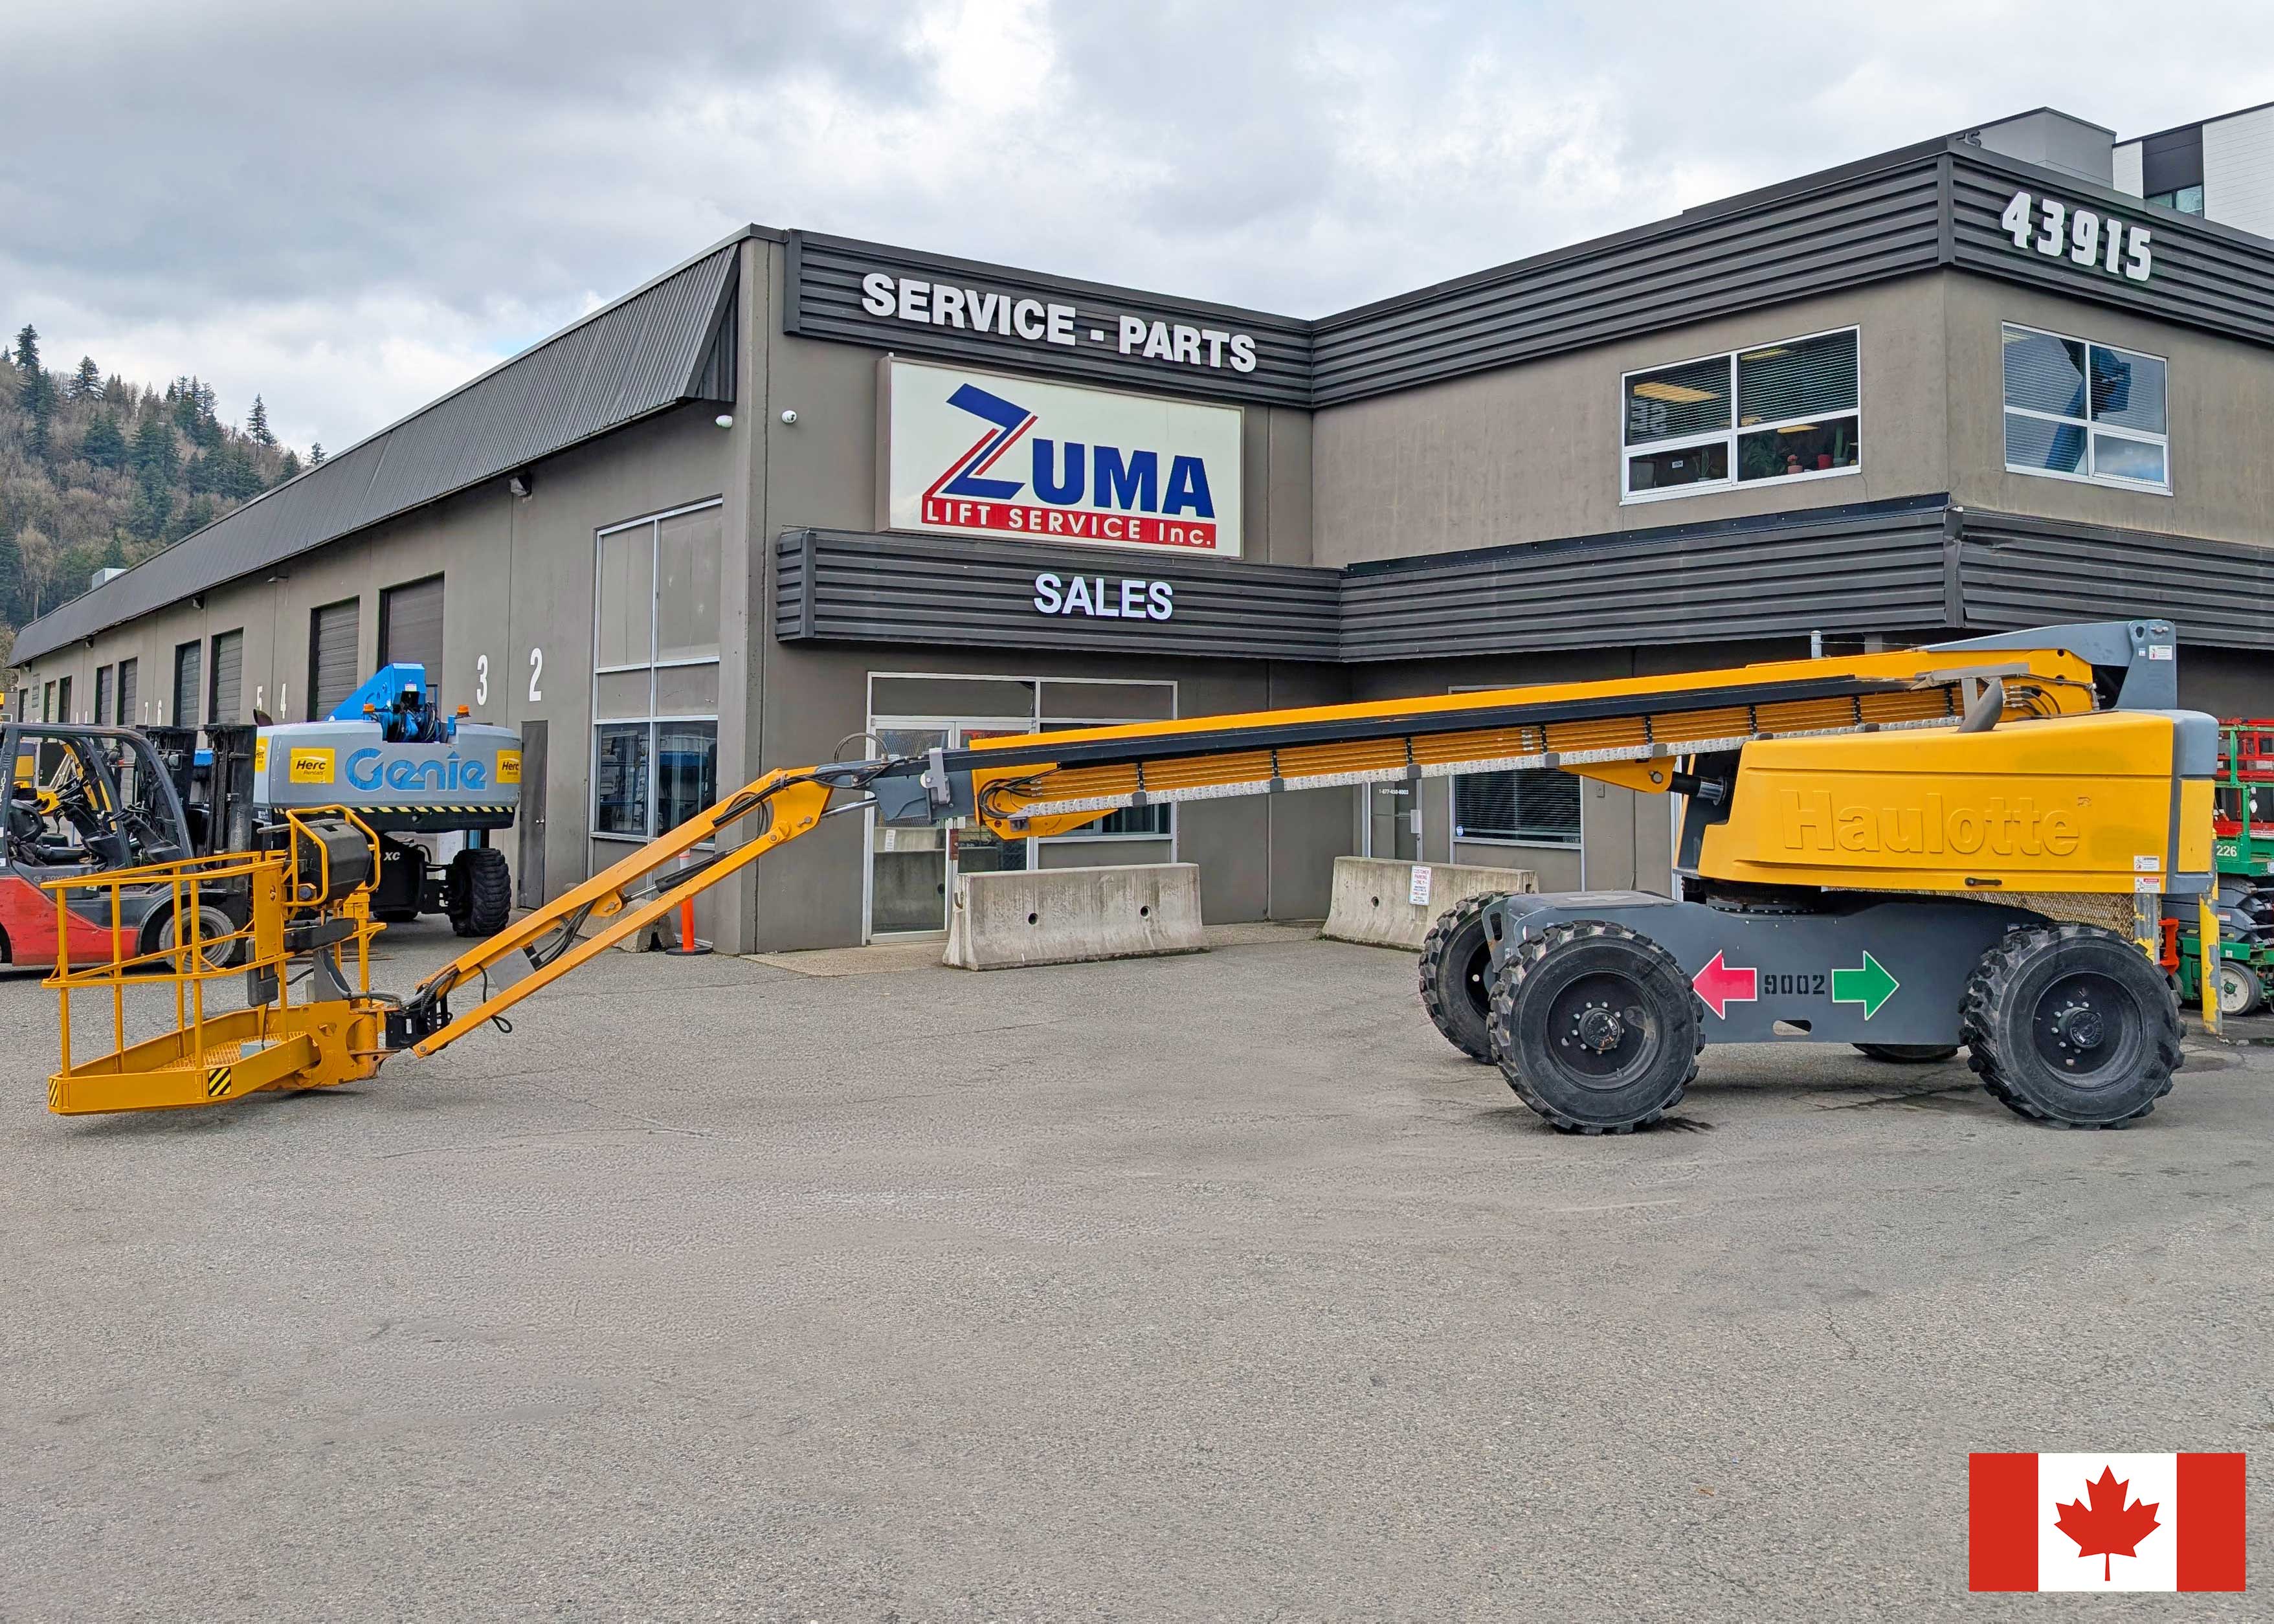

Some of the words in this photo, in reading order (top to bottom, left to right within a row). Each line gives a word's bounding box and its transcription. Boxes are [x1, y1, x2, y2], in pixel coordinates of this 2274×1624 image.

[2001, 191, 2152, 282] 43915
[862, 273, 1076, 347] SERVICE
[1119, 315, 1257, 373] PARTS
[926, 383, 1216, 518] ZUMA
[926, 500, 991, 526] LIFT
[1009, 508, 1141, 540] SERVICE
[1034, 573, 1174, 621] SALES
[476, 654, 488, 706] 3
[529, 647, 542, 702] 2
[280, 683, 287, 719] 4
[296, 760, 326, 770] Herc
[344, 748, 487, 792] Genie
[502, 761, 519, 771] Herc
[1779, 789, 2080, 856] Haulotte
[383, 852, 401, 861] XC
[2216, 845, 2238, 857] 226
[1764, 974, 1825, 995] 9002
